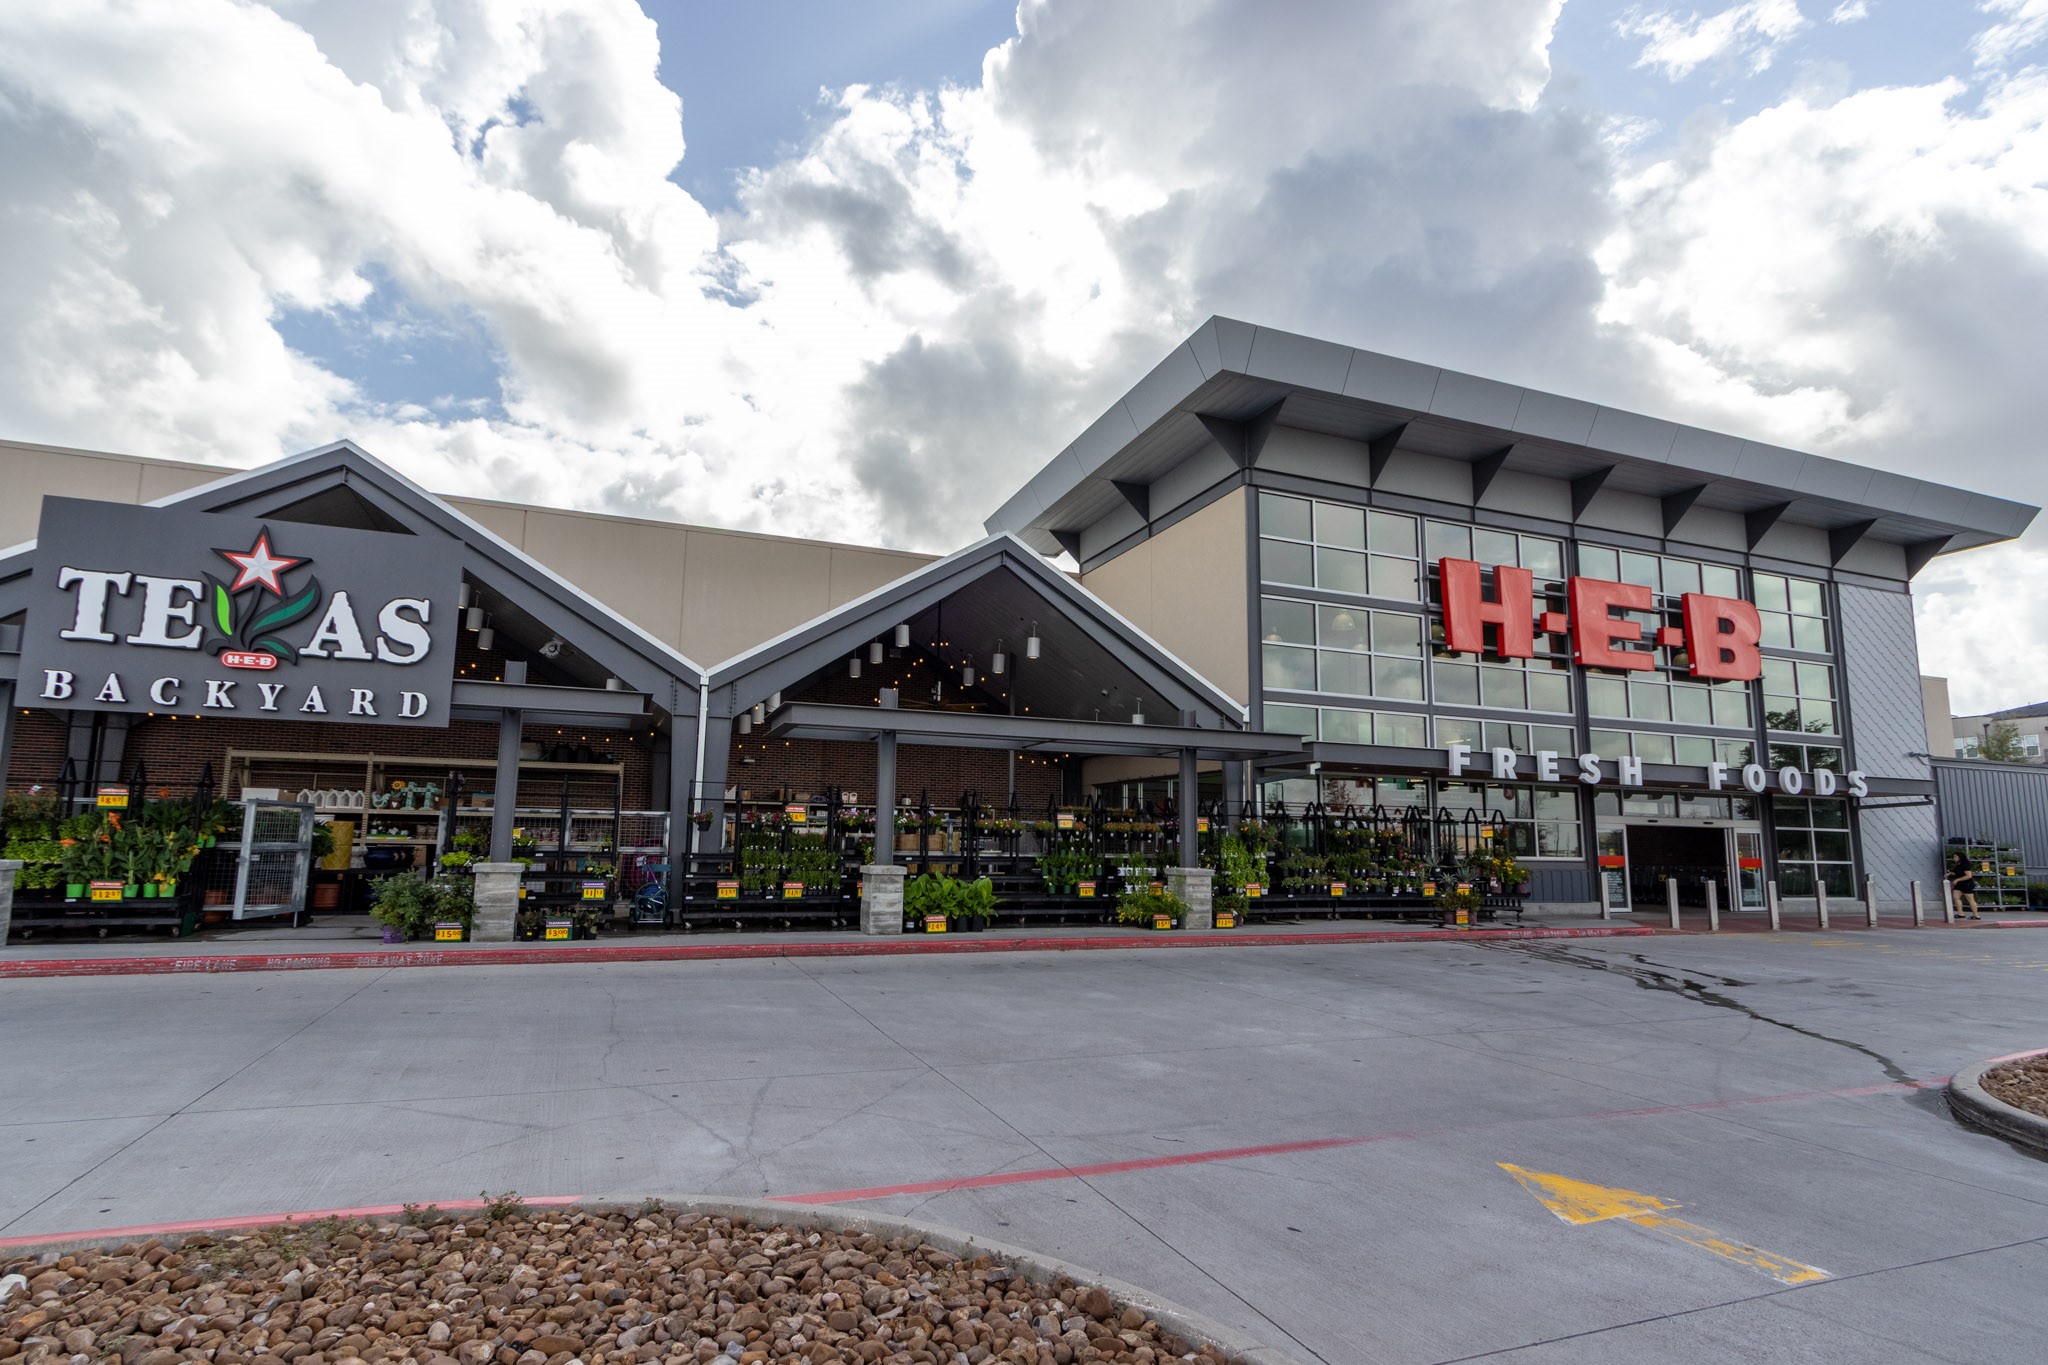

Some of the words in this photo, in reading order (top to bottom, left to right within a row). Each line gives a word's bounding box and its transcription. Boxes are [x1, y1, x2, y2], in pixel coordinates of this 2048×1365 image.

[40, 669, 429, 718] BACKYARD
[1448, 744, 1643, 787] FRESH
[1708, 761, 1868, 798] FOODS
